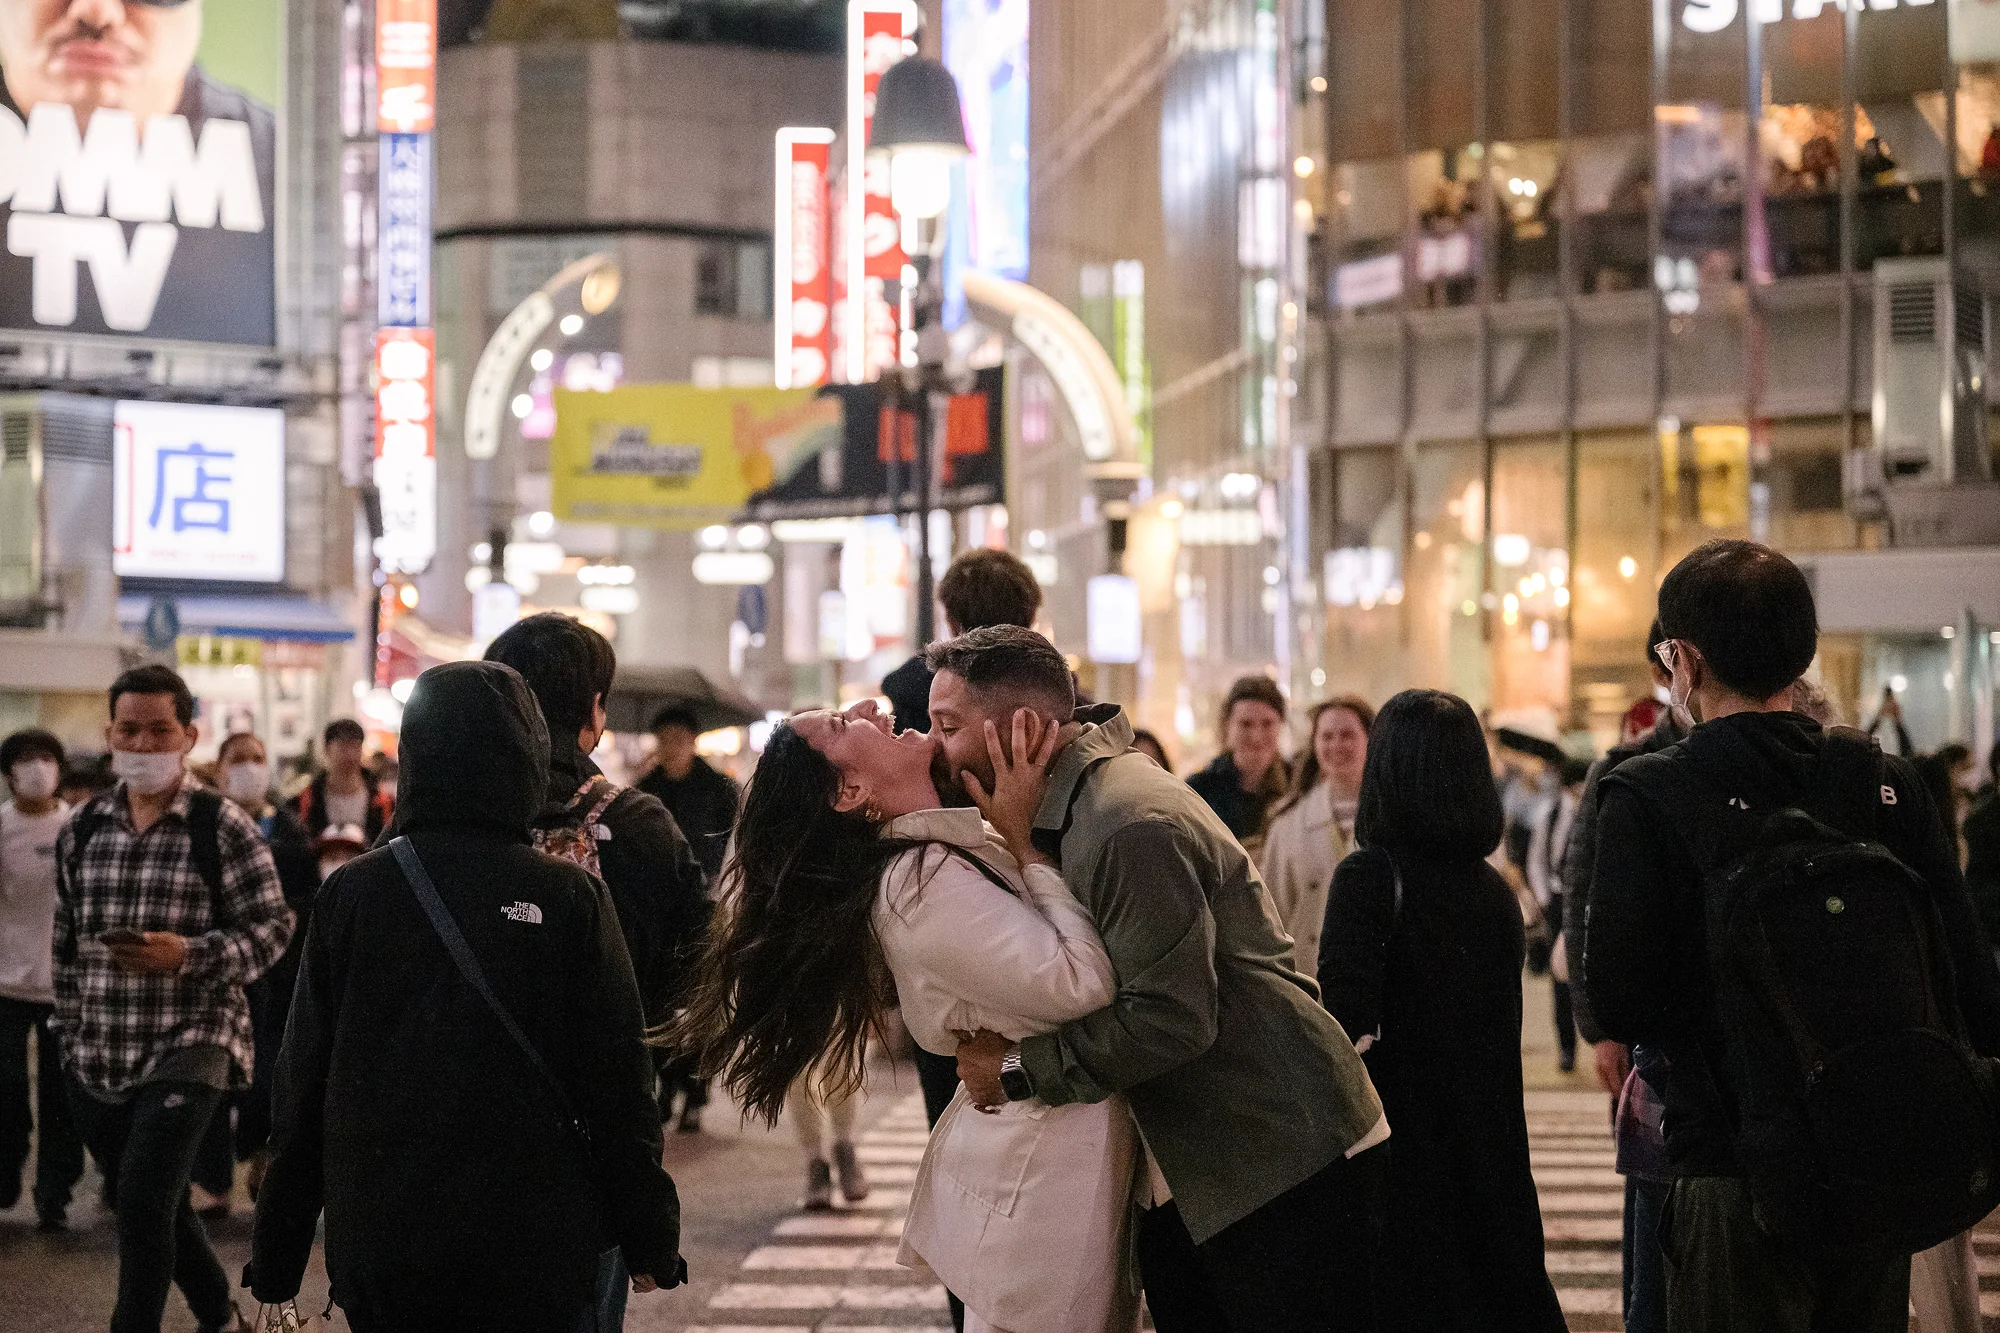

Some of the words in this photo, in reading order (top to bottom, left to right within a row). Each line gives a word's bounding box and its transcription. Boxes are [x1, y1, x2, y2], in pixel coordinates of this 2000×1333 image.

[7, 212, 178, 331] TV
[148, 443, 235, 533] 店
[514, 901, 529, 909] THE
[500, 906, 529, 916] NORTH
[507, 913, 528, 922] FACE
